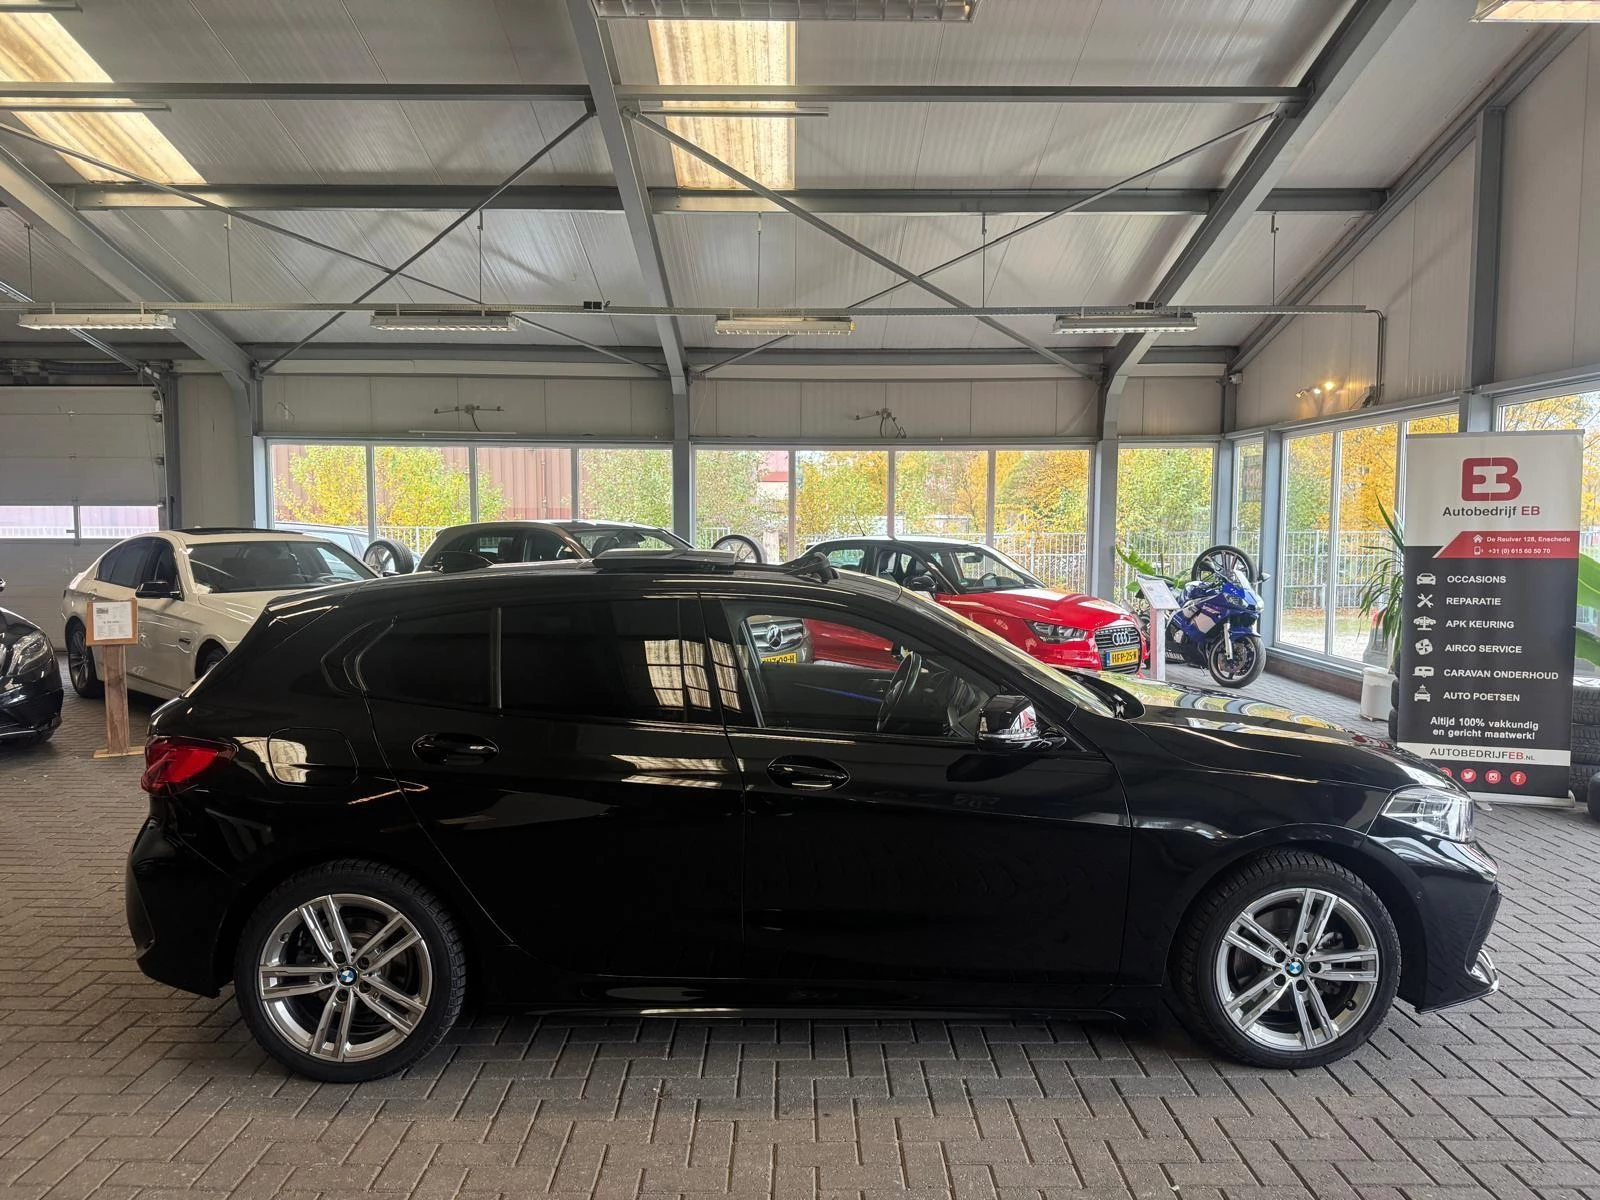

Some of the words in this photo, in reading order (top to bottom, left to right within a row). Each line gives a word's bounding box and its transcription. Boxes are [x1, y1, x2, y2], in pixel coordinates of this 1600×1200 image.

[1461, 457, 1522, 501] EB
[1442, 507, 1517, 518] Autobedrijf
[1521, 506, 1540, 516] EB
[1447, 575, 1507, 584] OCCASIONS
[1446, 597, 1502, 606] REPARATIE
[1445, 620, 1467, 628] APK
[1469, 620, 1514, 629] KEURING
[1445, 644, 1477, 653] AIRCO
[1478, 645, 1523, 654] SERVICE
[1443, 669, 1491, 678] CARAVAN
[1493, 670, 1559, 680] ONDERHOUD
[1443, 692, 1471, 700] AUTO
[1473, 692, 1521, 702] POETSEN
[1430, 716, 1455, 727] Altijd
[1458, 718, 1485, 727] 100%
[1488, 720, 1539, 731] vakkundig
[1448, 729, 1482, 738] gericht
[1484, 731, 1536, 740] maatwerk!
[1429, 747, 1536, 761] AUTOBEDRIJFEB.NL
